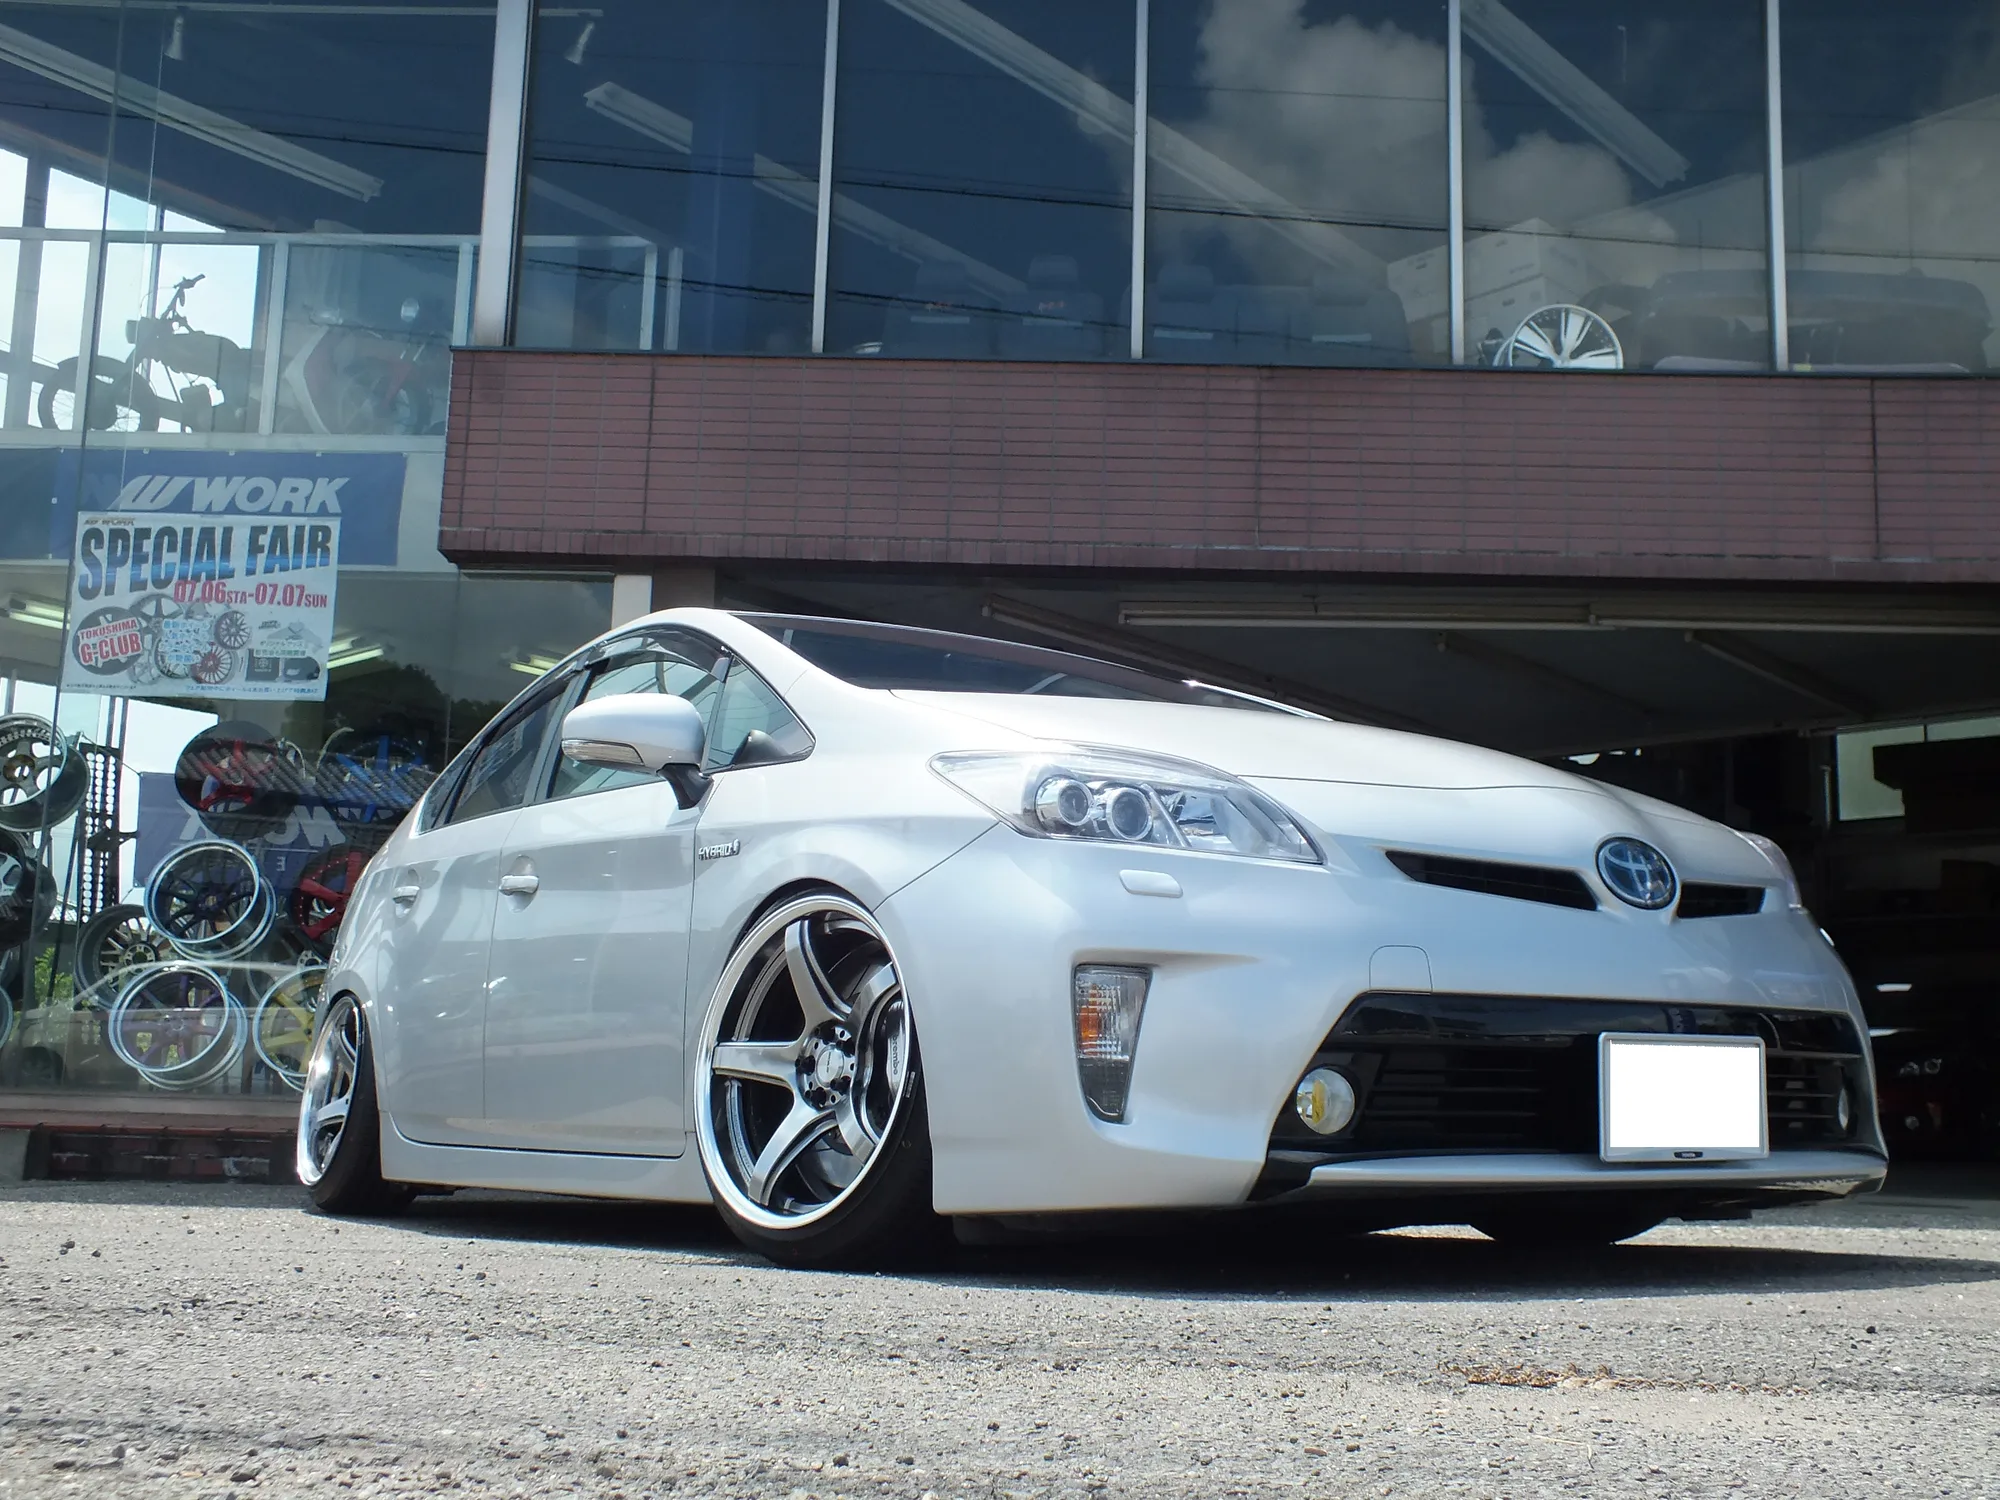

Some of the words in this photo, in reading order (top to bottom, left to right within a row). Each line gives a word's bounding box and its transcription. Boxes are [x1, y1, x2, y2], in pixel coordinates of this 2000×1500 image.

[192, 476, 349, 513] WORK
[78, 526, 235, 601] SPECIAL
[245, 525, 332, 577] FAIR
[80, 619, 137, 640] TOKUSHIMA
[80, 633, 142, 664] G-CLUB
[698, 842, 733, 860] HYBRID
[892, 1034, 900, 1076] brembo
